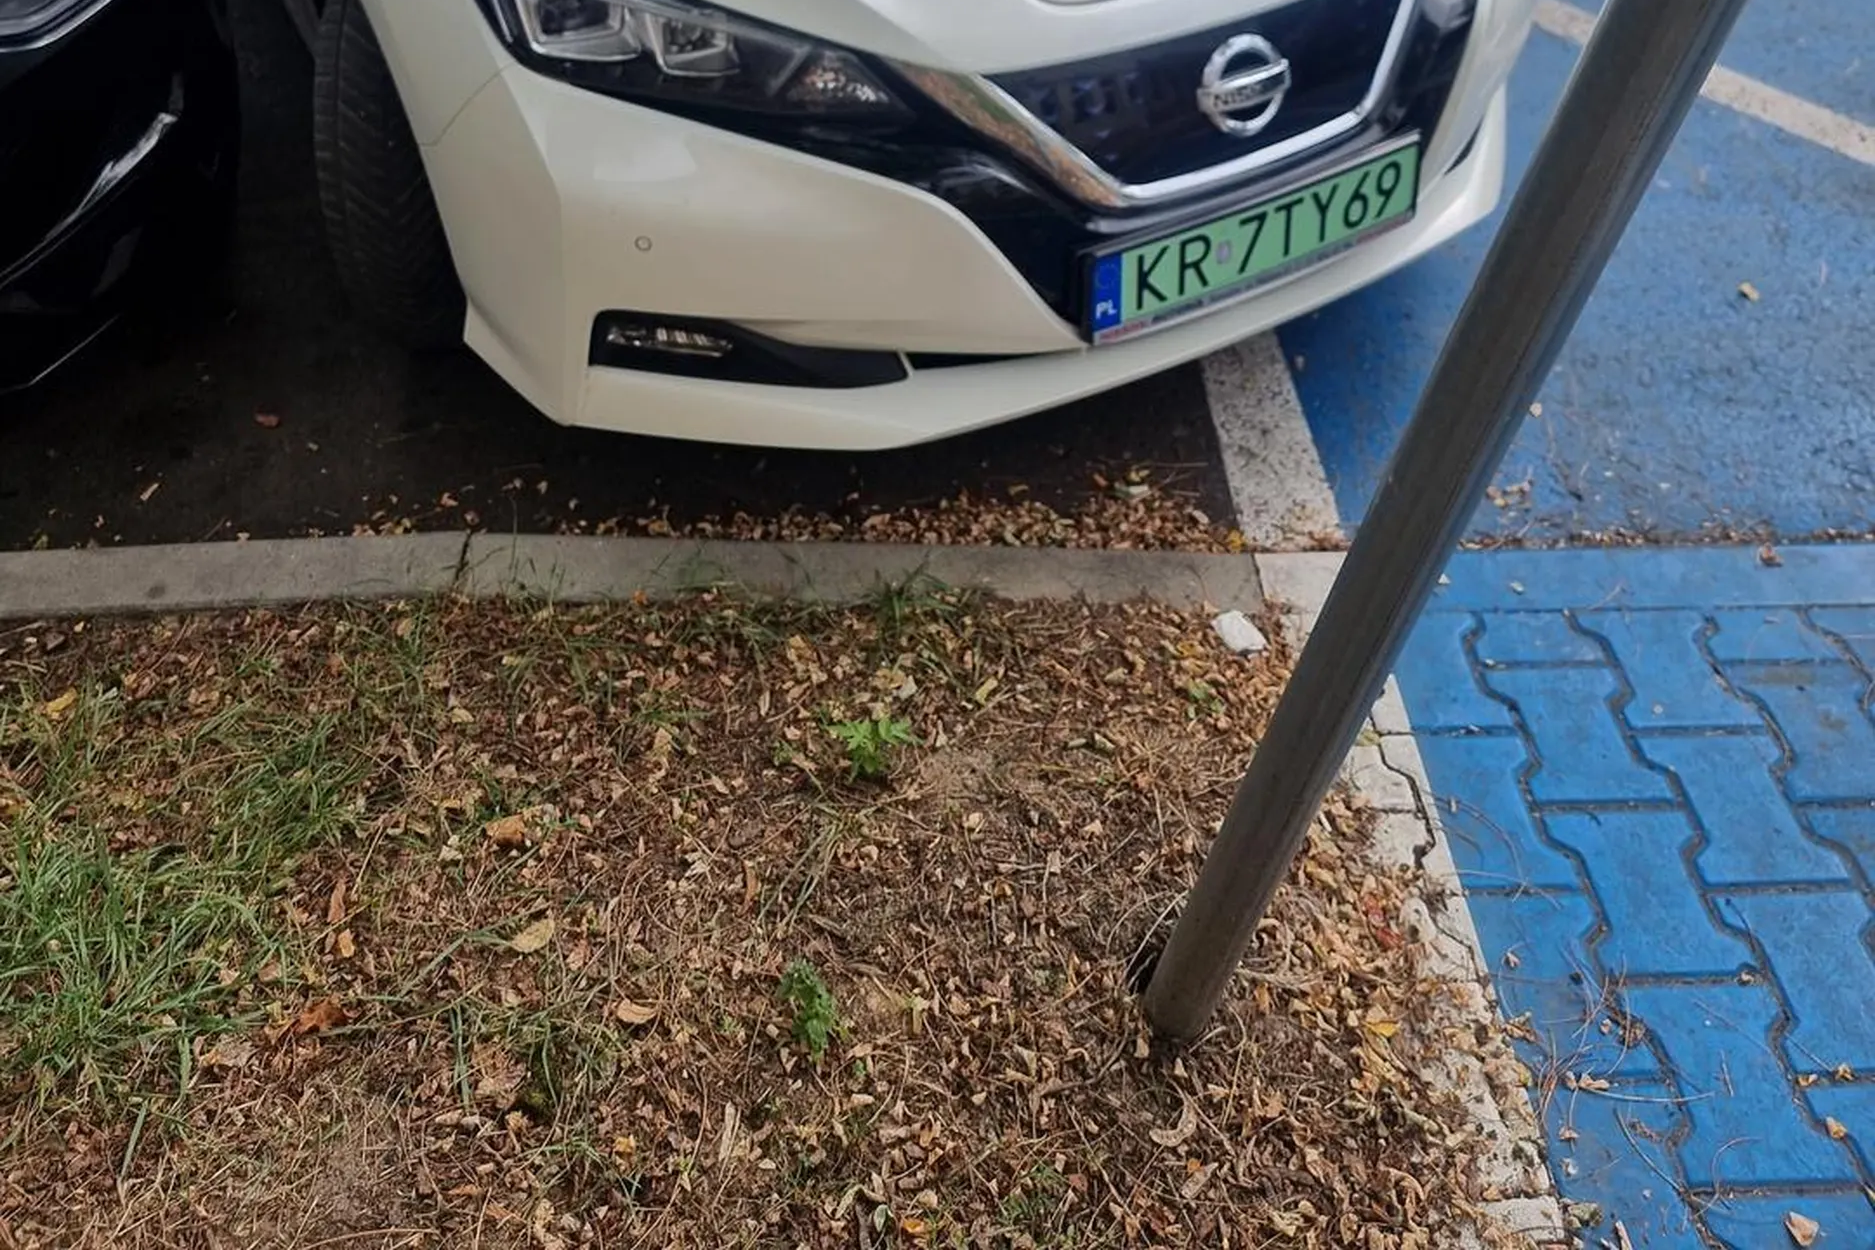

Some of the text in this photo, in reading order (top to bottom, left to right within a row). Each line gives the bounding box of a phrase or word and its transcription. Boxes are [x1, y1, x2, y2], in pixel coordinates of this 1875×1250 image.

[1136, 234, 1212, 311] KR
[1238, 160, 1401, 275] 7TY69
[1095, 299, 1118, 320] PL
